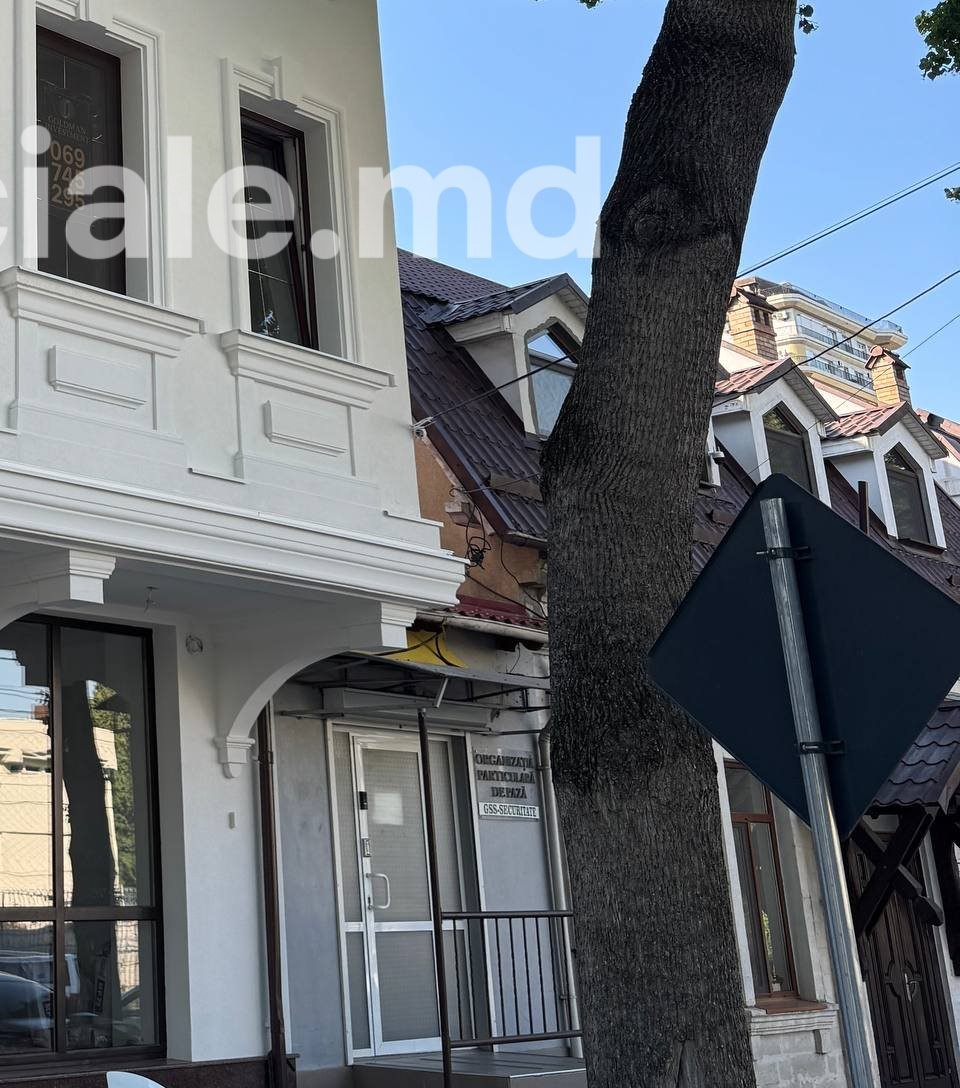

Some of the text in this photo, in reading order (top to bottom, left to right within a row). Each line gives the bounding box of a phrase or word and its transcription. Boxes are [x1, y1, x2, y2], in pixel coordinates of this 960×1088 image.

[50, 140, 85, 168] 069
[51, 161, 85, 190] 745
[51, 183, 85, 209] 295
[491, 786, 506, 798] DE
[483, 804, 537, 817] GSS-SECURITATE
